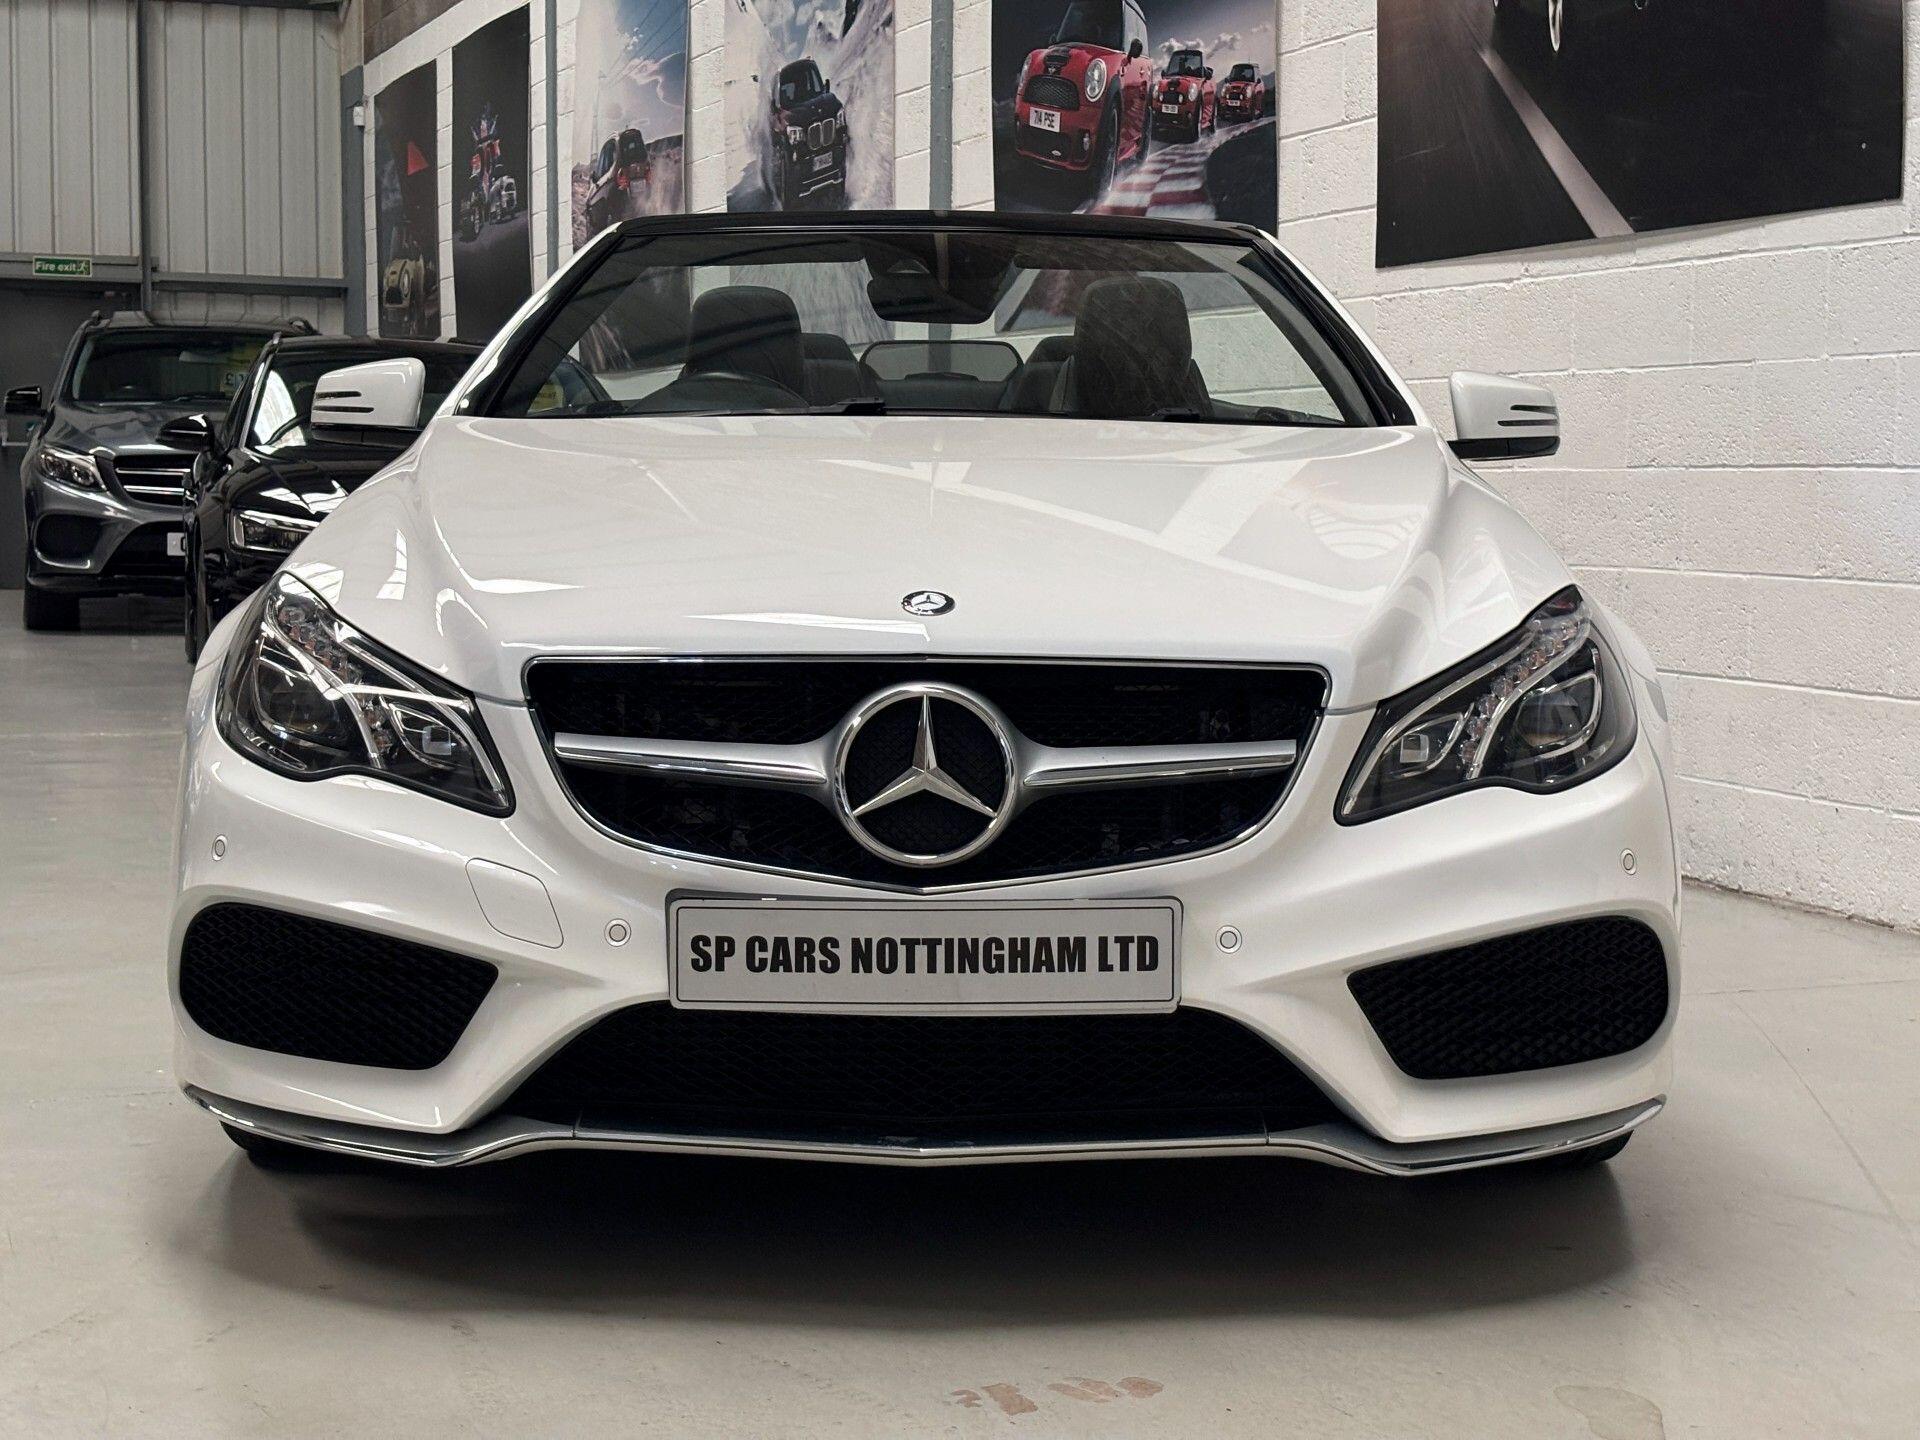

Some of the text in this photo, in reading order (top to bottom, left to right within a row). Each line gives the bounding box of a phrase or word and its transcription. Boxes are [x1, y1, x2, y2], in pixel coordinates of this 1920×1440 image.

[35, 261, 77, 272] Fire exit
[690, 934, 1159, 975] SP CARS NOTTINGHAM LTD
